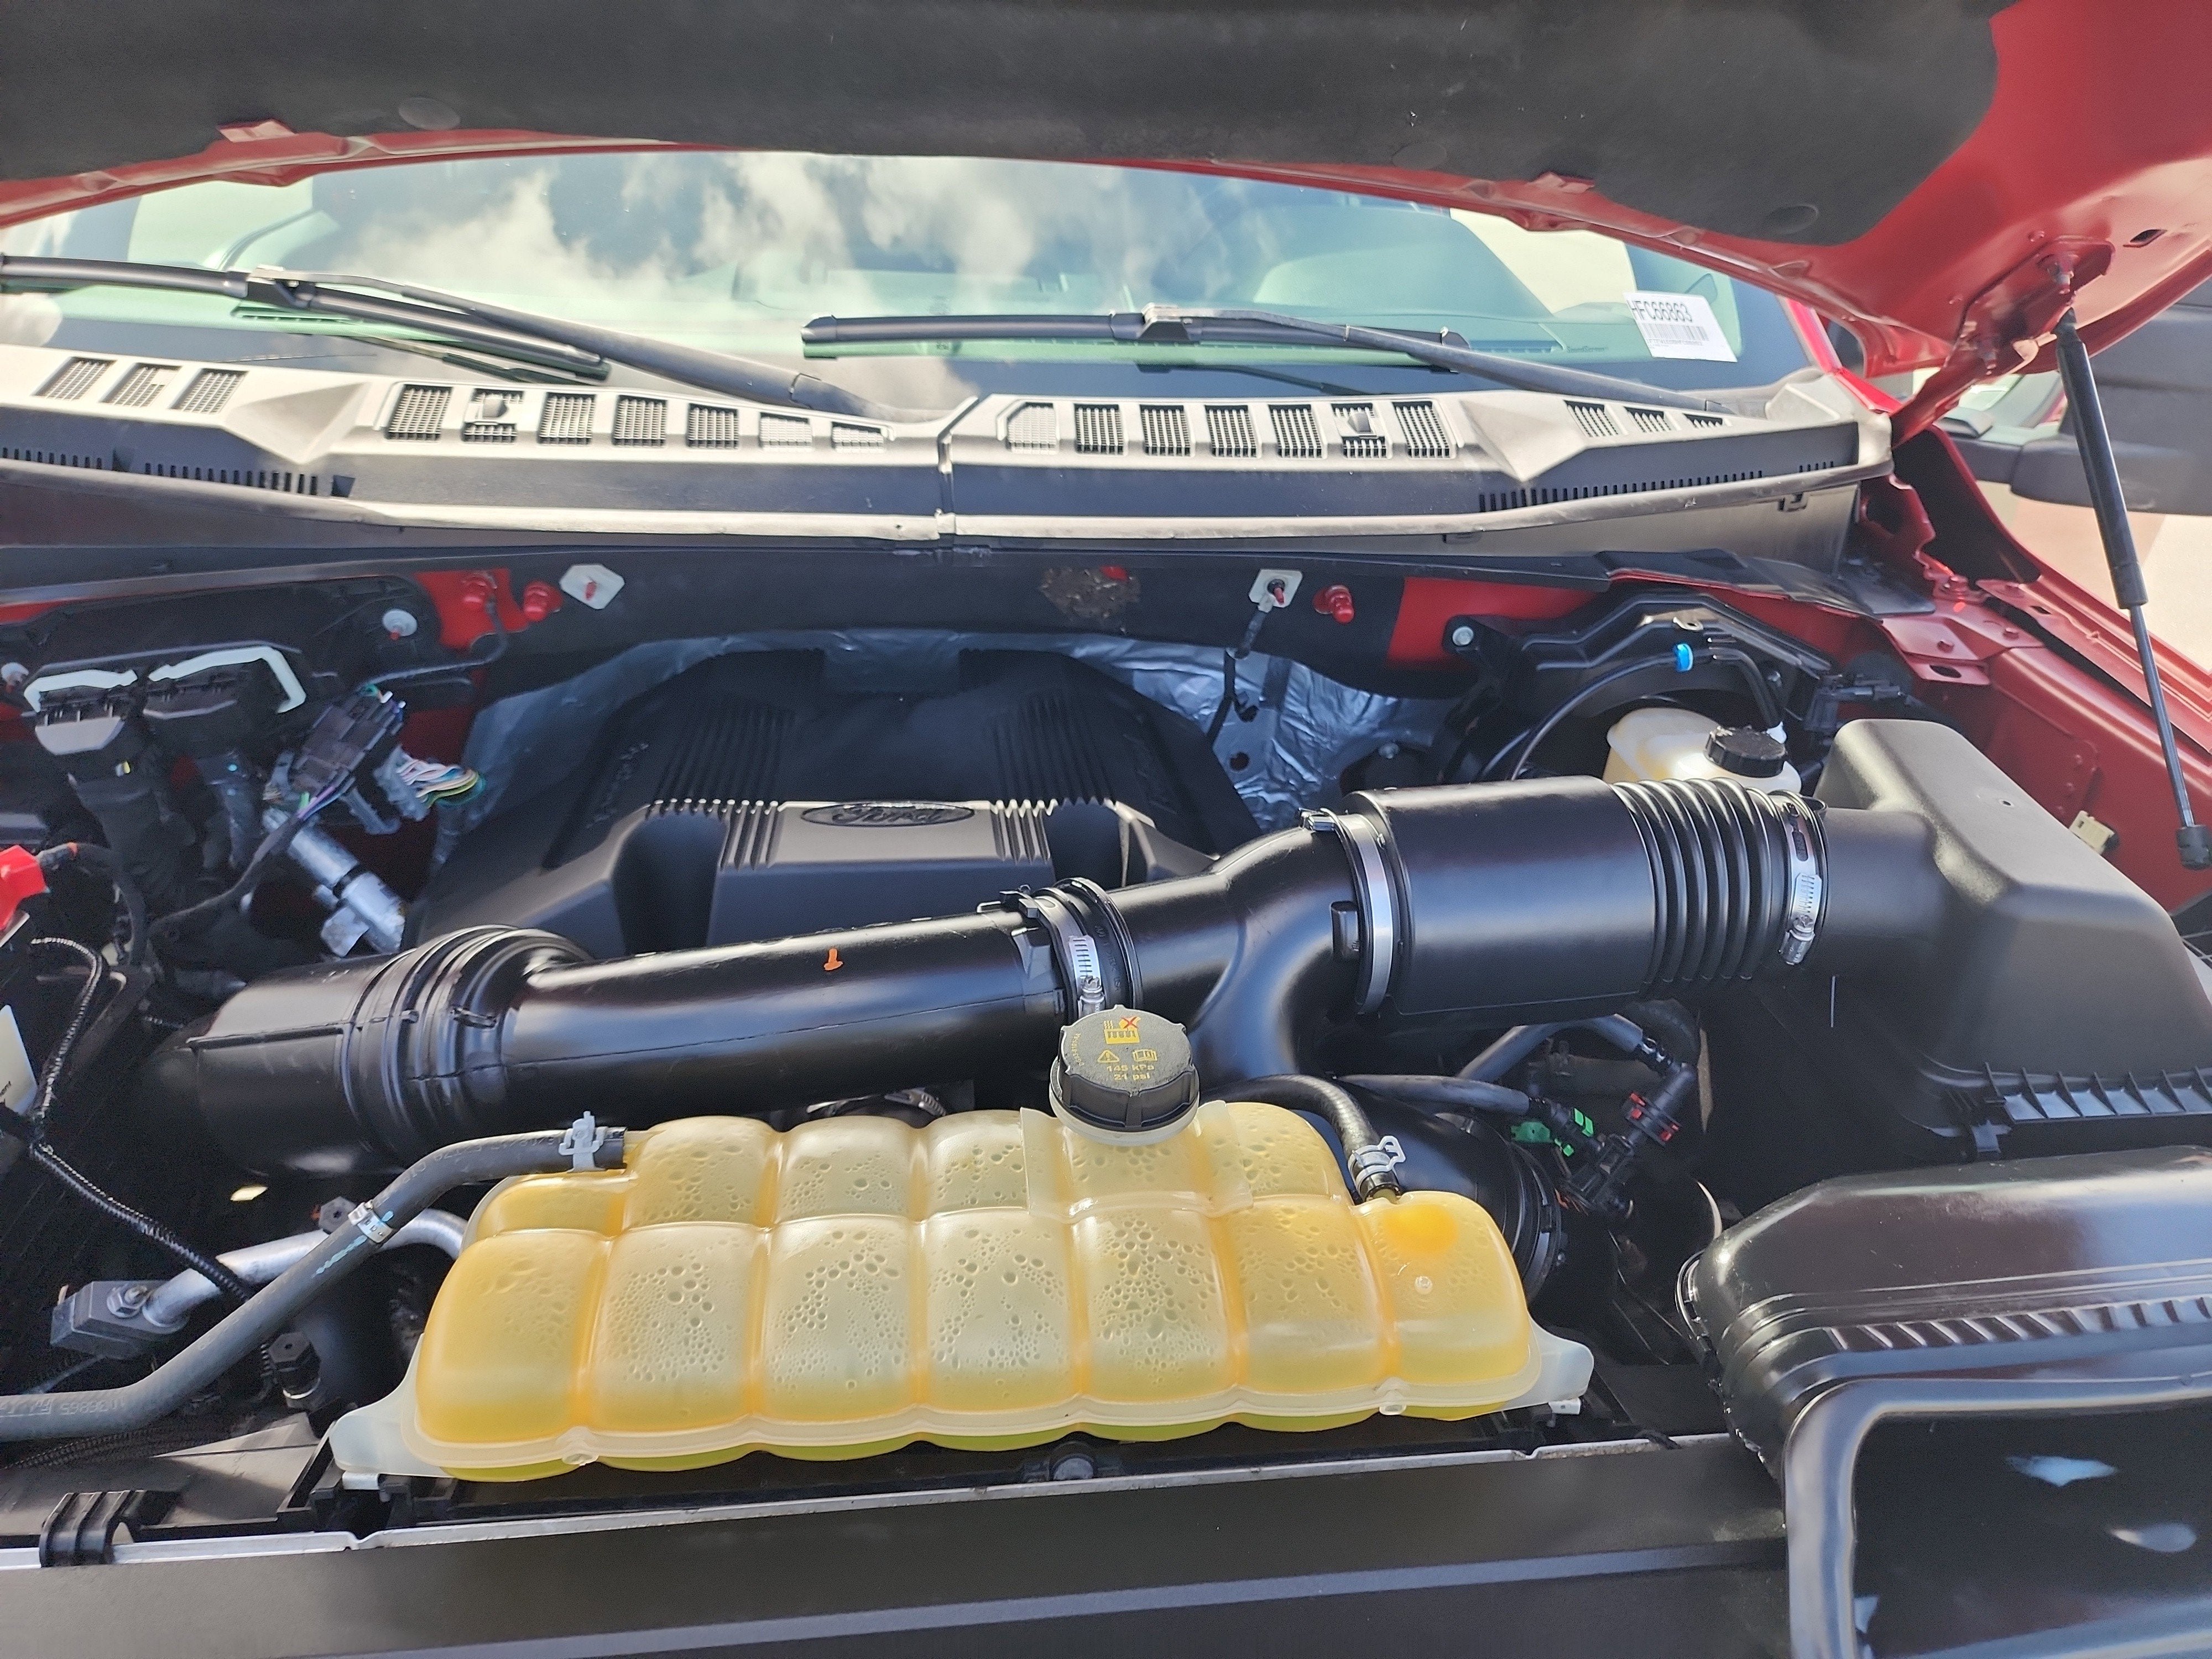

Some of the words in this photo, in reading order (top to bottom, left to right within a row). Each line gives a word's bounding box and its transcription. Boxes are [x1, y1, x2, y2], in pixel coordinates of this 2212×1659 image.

[1627, 300, 1692, 322] HFC66863
[831, 804, 946, 823] Ford
[1133, 1072, 1150, 1081] psi
